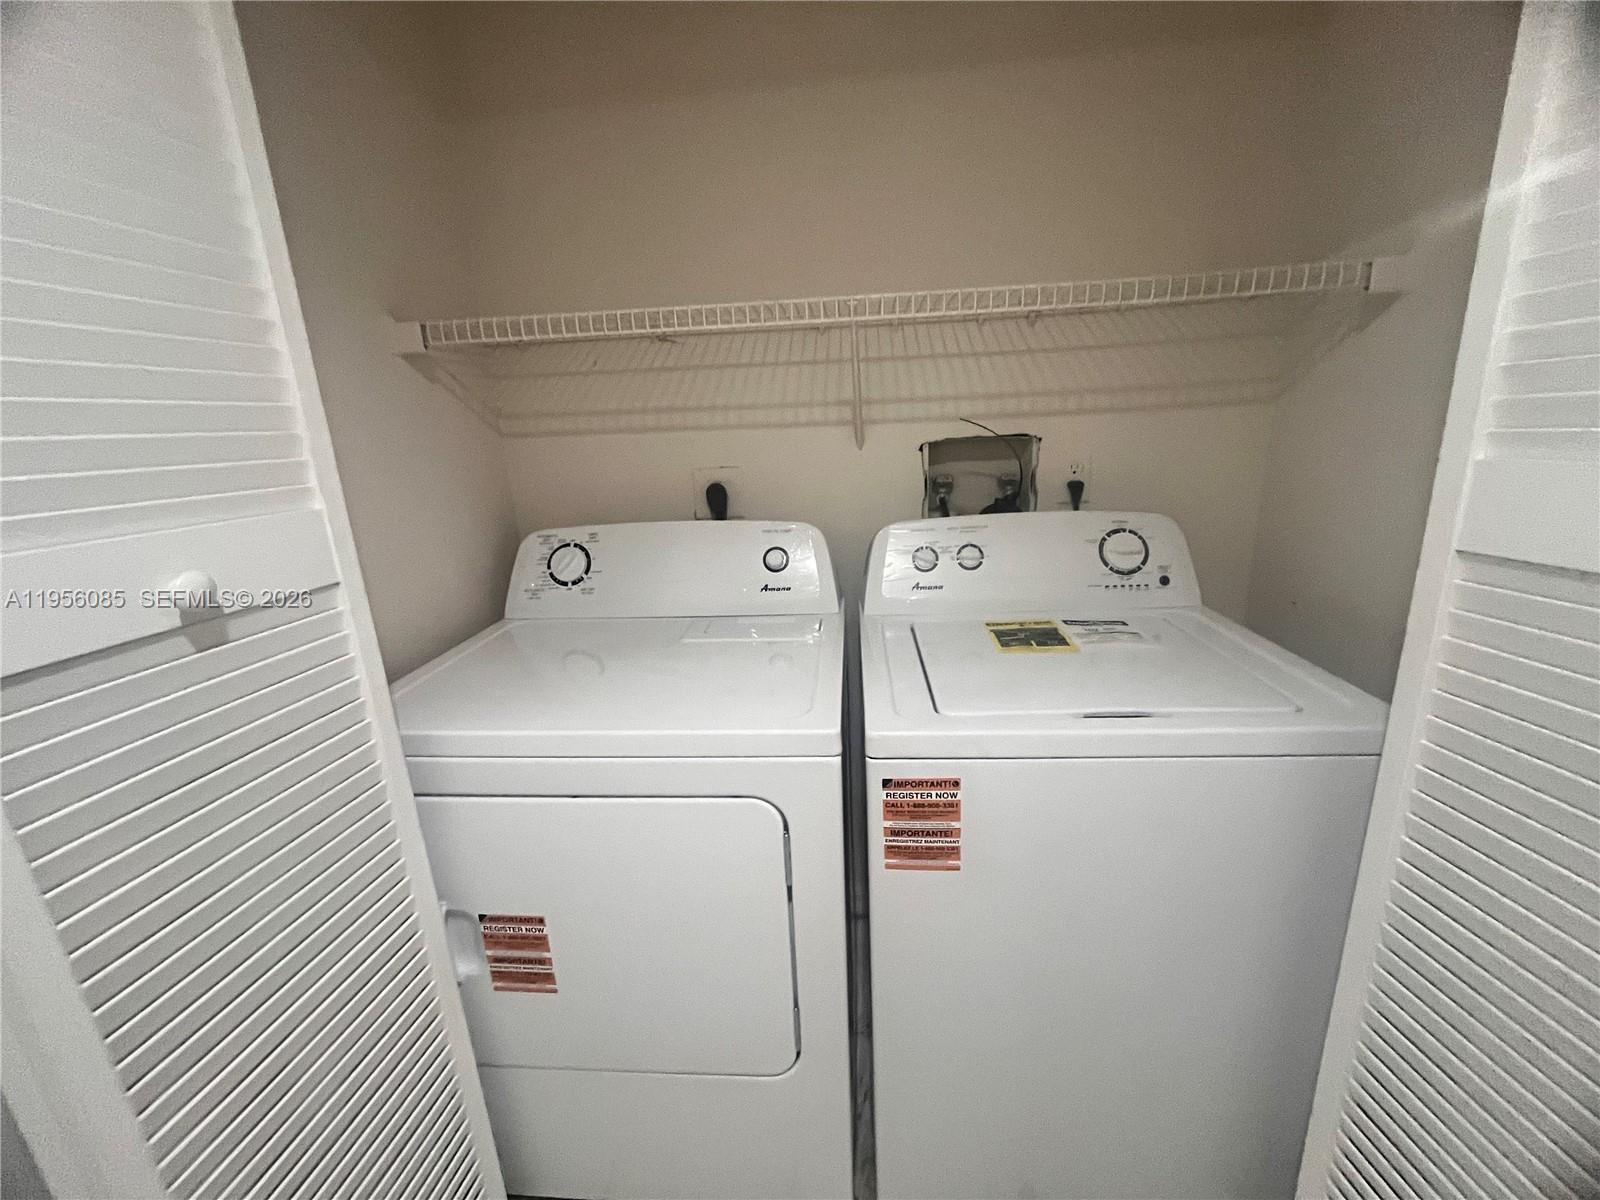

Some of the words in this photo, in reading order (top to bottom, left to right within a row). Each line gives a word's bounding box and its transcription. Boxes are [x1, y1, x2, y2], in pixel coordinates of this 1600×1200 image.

[760, 583, 792, 593] Amana
[912, 581, 944, 591] Amana
[890, 830, 953, 838] IMPORTANTE!
